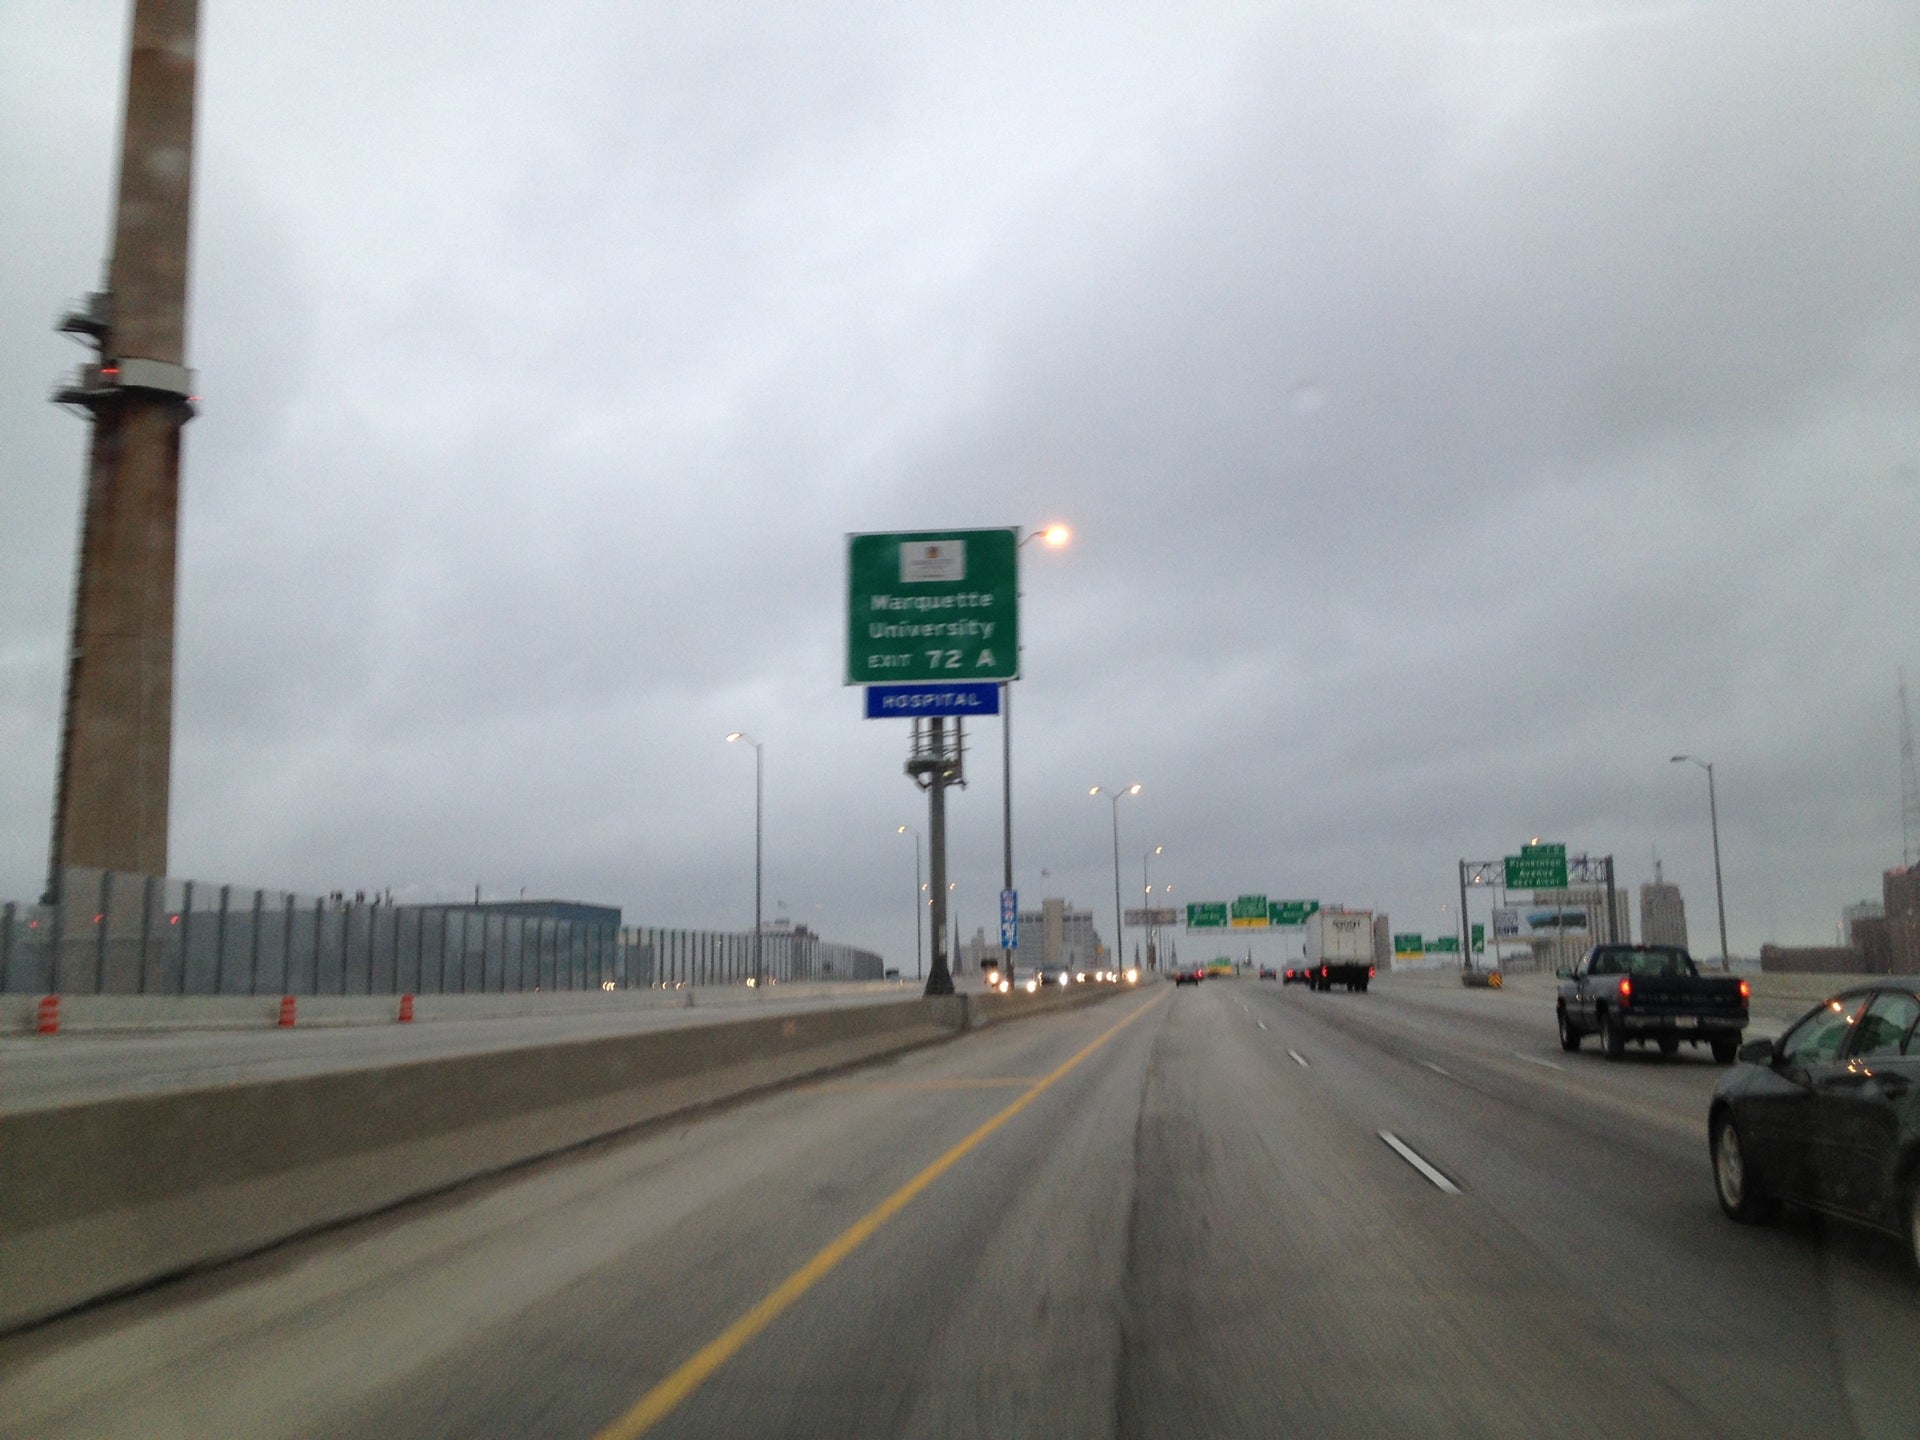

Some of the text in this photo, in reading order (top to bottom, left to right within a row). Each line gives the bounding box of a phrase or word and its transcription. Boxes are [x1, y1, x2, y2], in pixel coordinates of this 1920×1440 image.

[870, 592, 993, 612] Marquette
[869, 619, 996, 639] University
[868, 649, 996, 668] EXIT 72 A
[882, 692, 982, 709] HOSPITAL
